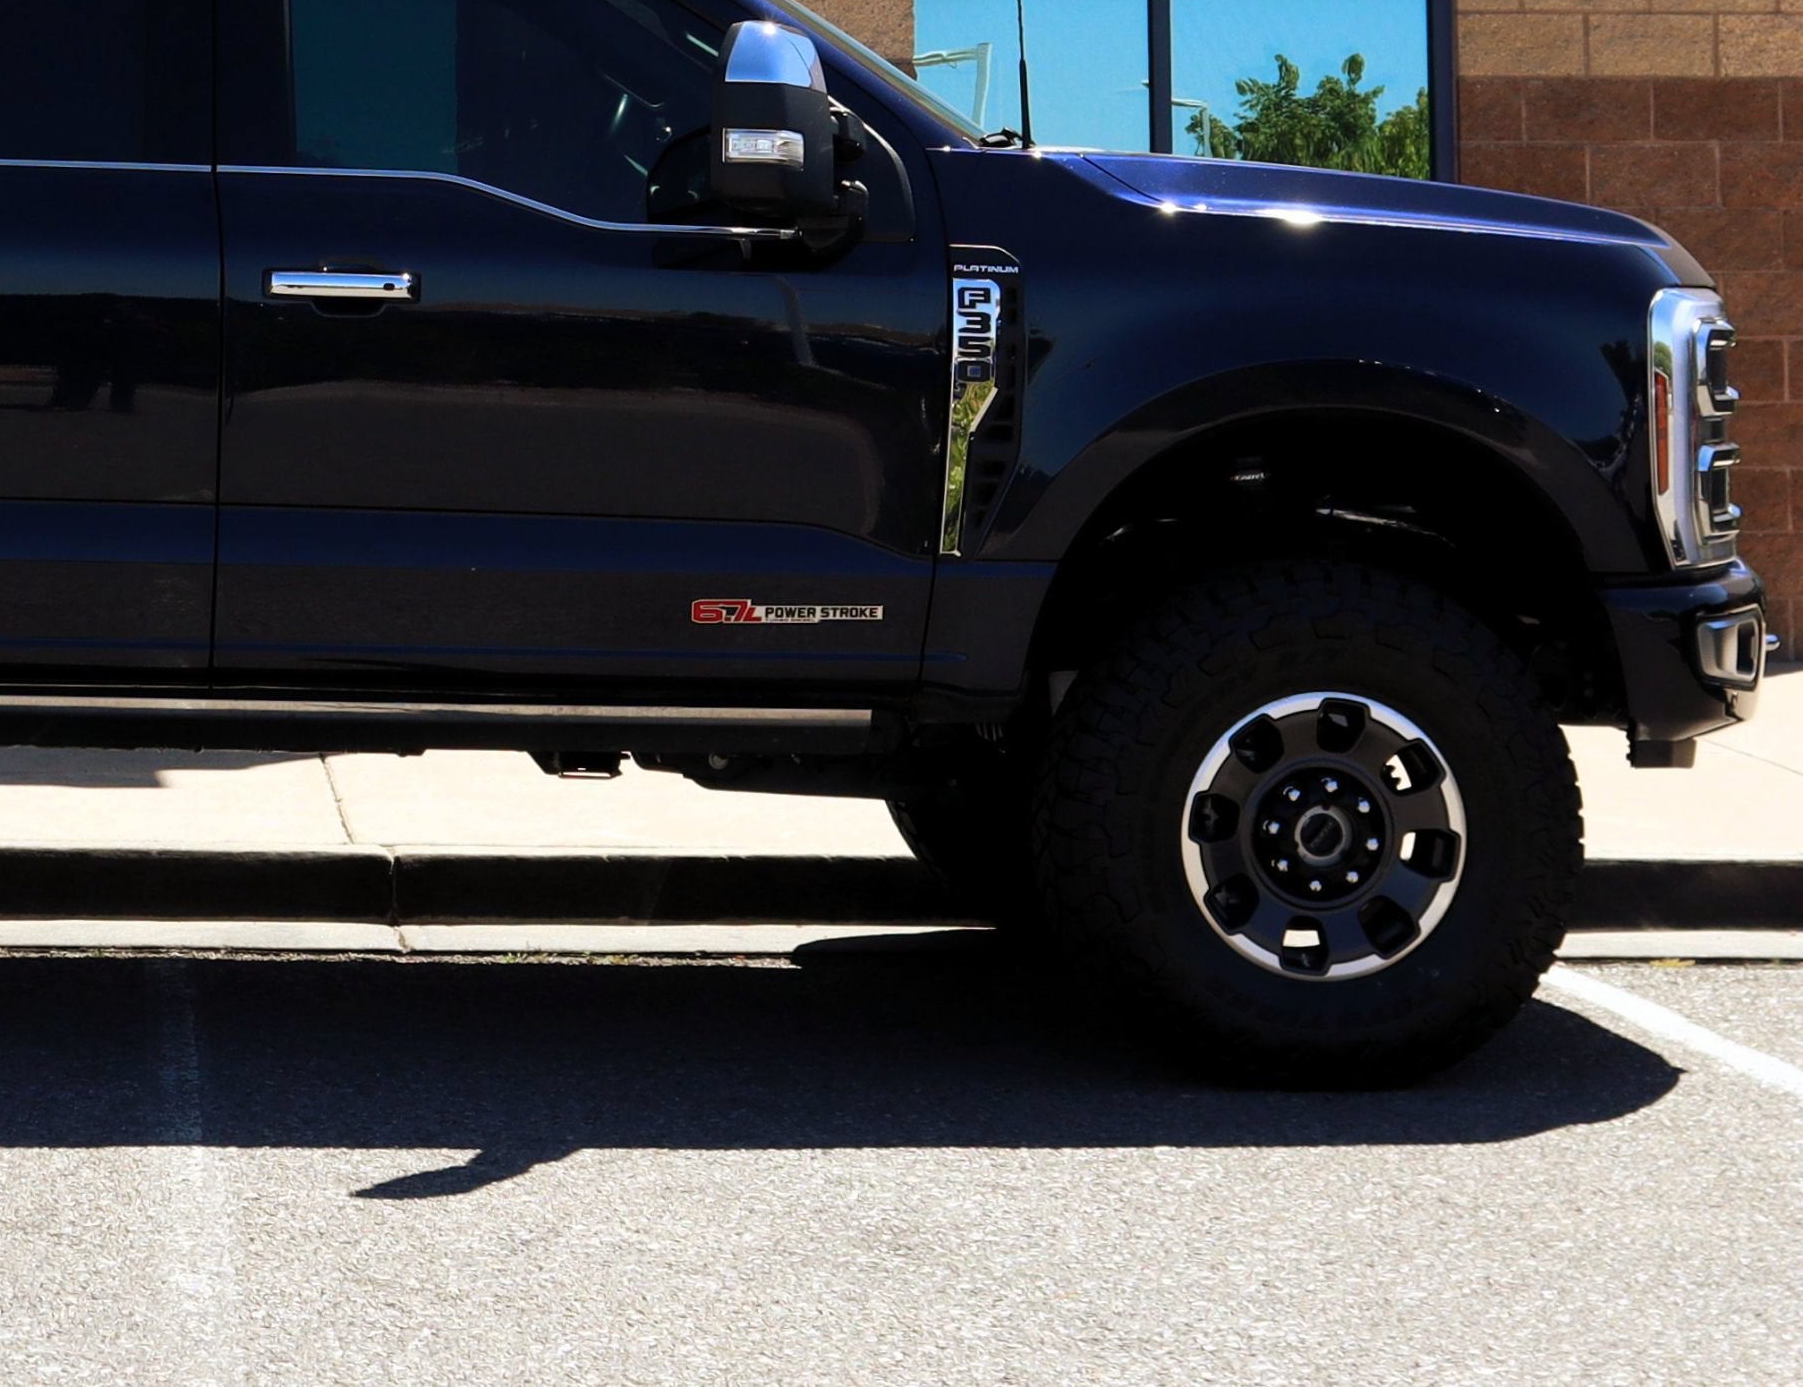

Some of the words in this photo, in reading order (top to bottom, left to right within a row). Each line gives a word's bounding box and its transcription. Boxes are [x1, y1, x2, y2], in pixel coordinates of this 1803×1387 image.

[953, 264, 1019, 274] PLATINUM
[957, 286, 992, 383] F350
[691, 599, 763, 623] 6.7L
[765, 606, 817, 619] POWER
[820, 606, 879, 619] STROKE
